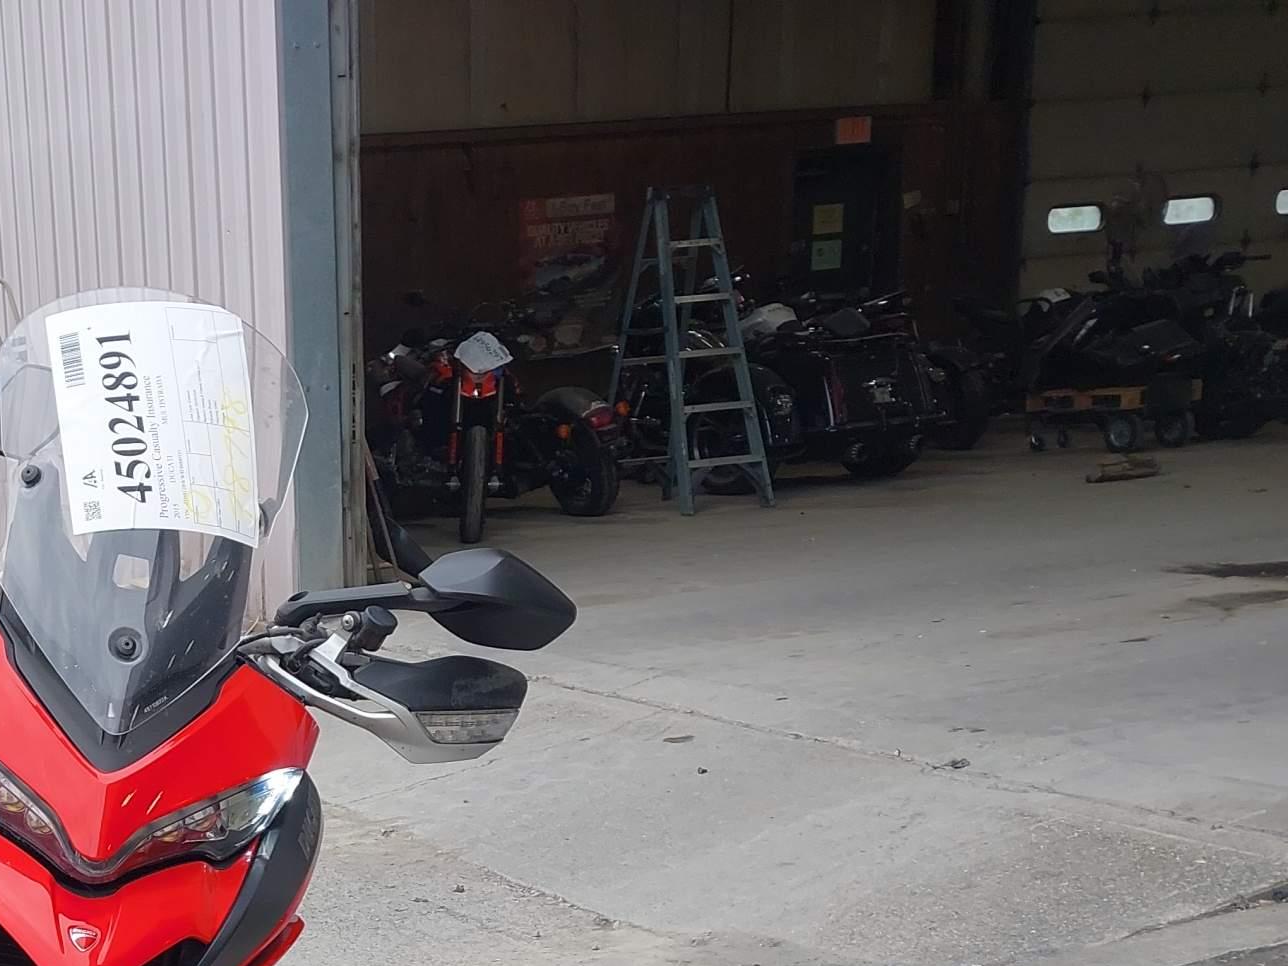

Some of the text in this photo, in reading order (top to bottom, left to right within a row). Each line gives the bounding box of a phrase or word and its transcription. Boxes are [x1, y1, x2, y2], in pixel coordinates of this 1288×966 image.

[96, 329, 153, 503] 45024891
[143, 375, 170, 519] Progressive Casualty Insurance
